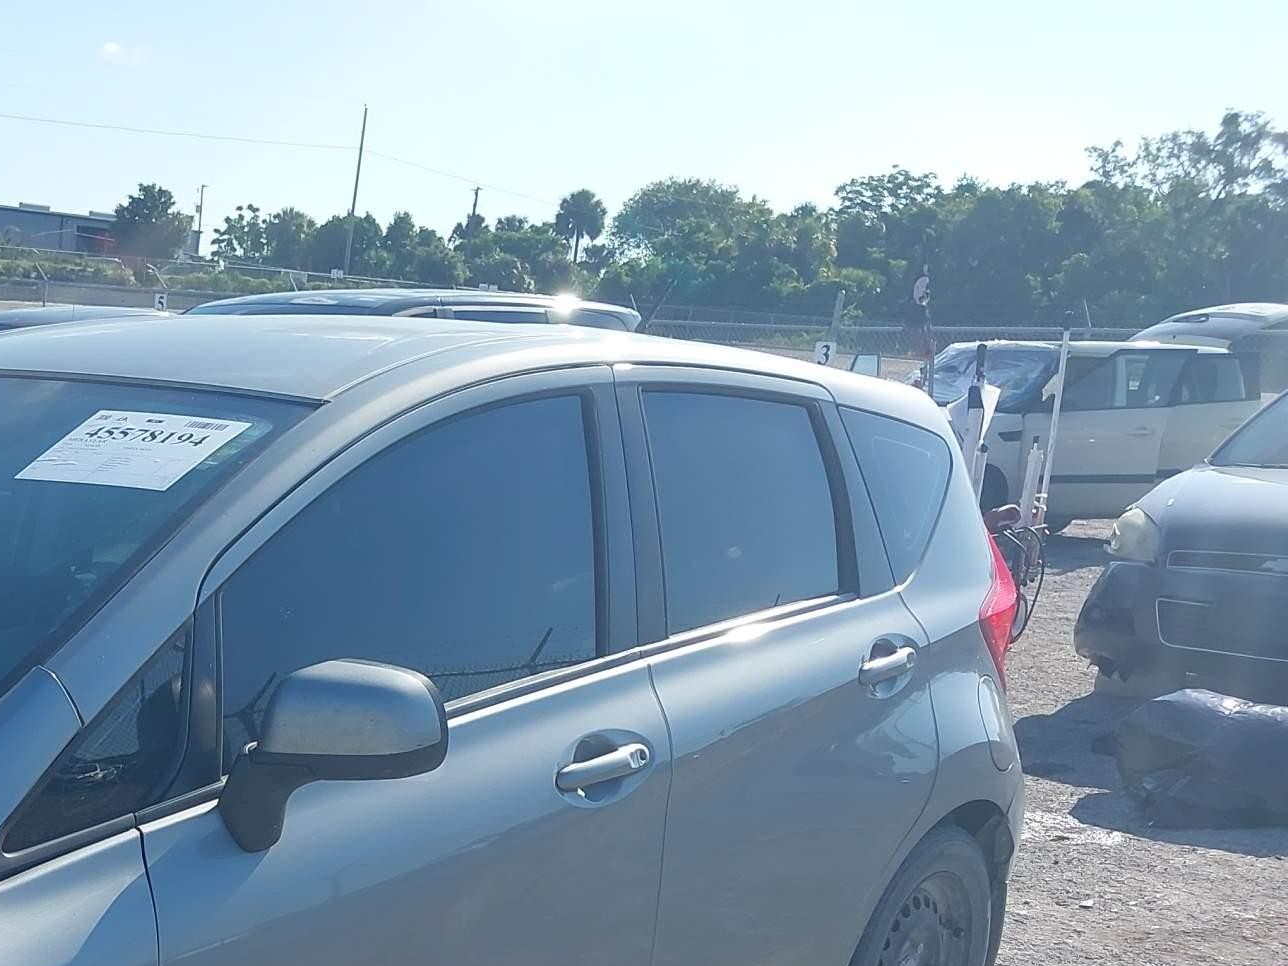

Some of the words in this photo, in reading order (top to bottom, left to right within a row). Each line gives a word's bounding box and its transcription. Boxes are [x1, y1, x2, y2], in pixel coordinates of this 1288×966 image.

[157, 295, 165, 310] 5
[816, 344, 831, 366] 3
[84, 425, 211, 447] 45578194
